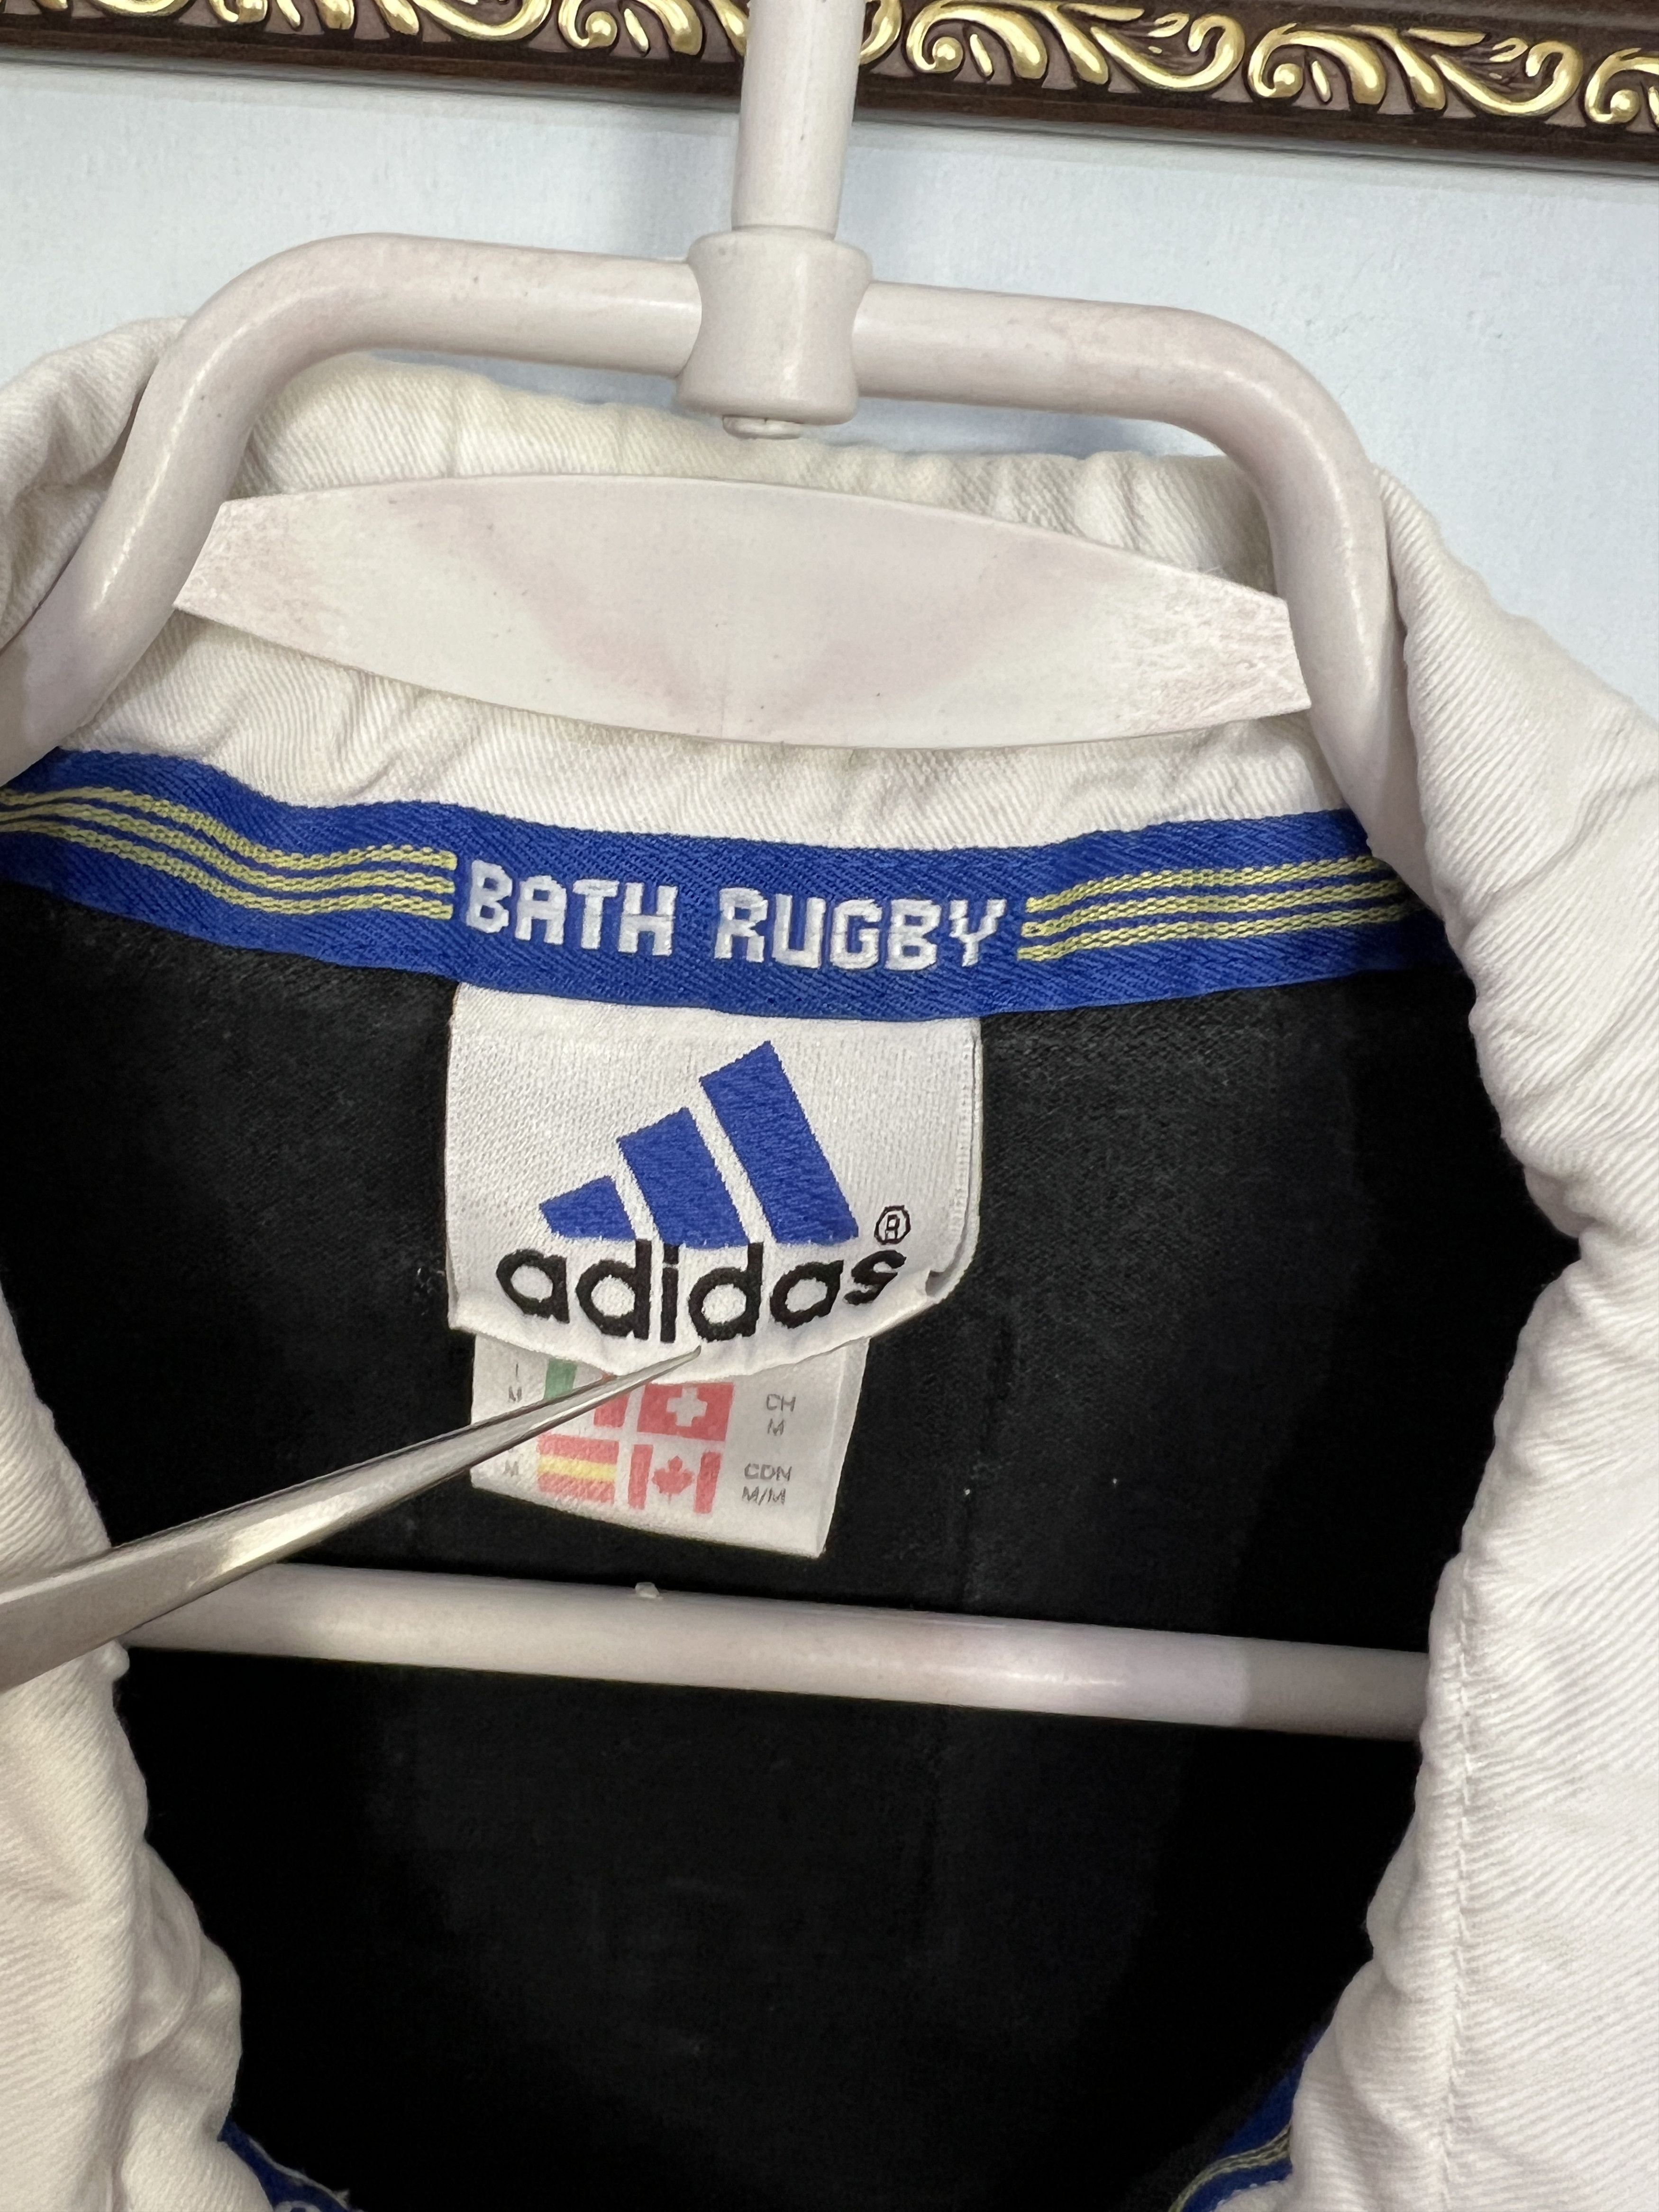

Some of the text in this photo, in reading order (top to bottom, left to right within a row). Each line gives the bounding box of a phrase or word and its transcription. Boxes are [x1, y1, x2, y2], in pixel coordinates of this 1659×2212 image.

[466, 860, 1007, 972] BATH RUGBY
[496, 1238, 907, 1343] adidas
[766, 1393, 796, 1412] CH
[767, 1418, 785, 1436] M
[744, 1463, 793, 1482] CDN
[742, 1486, 786, 1506] M/M
